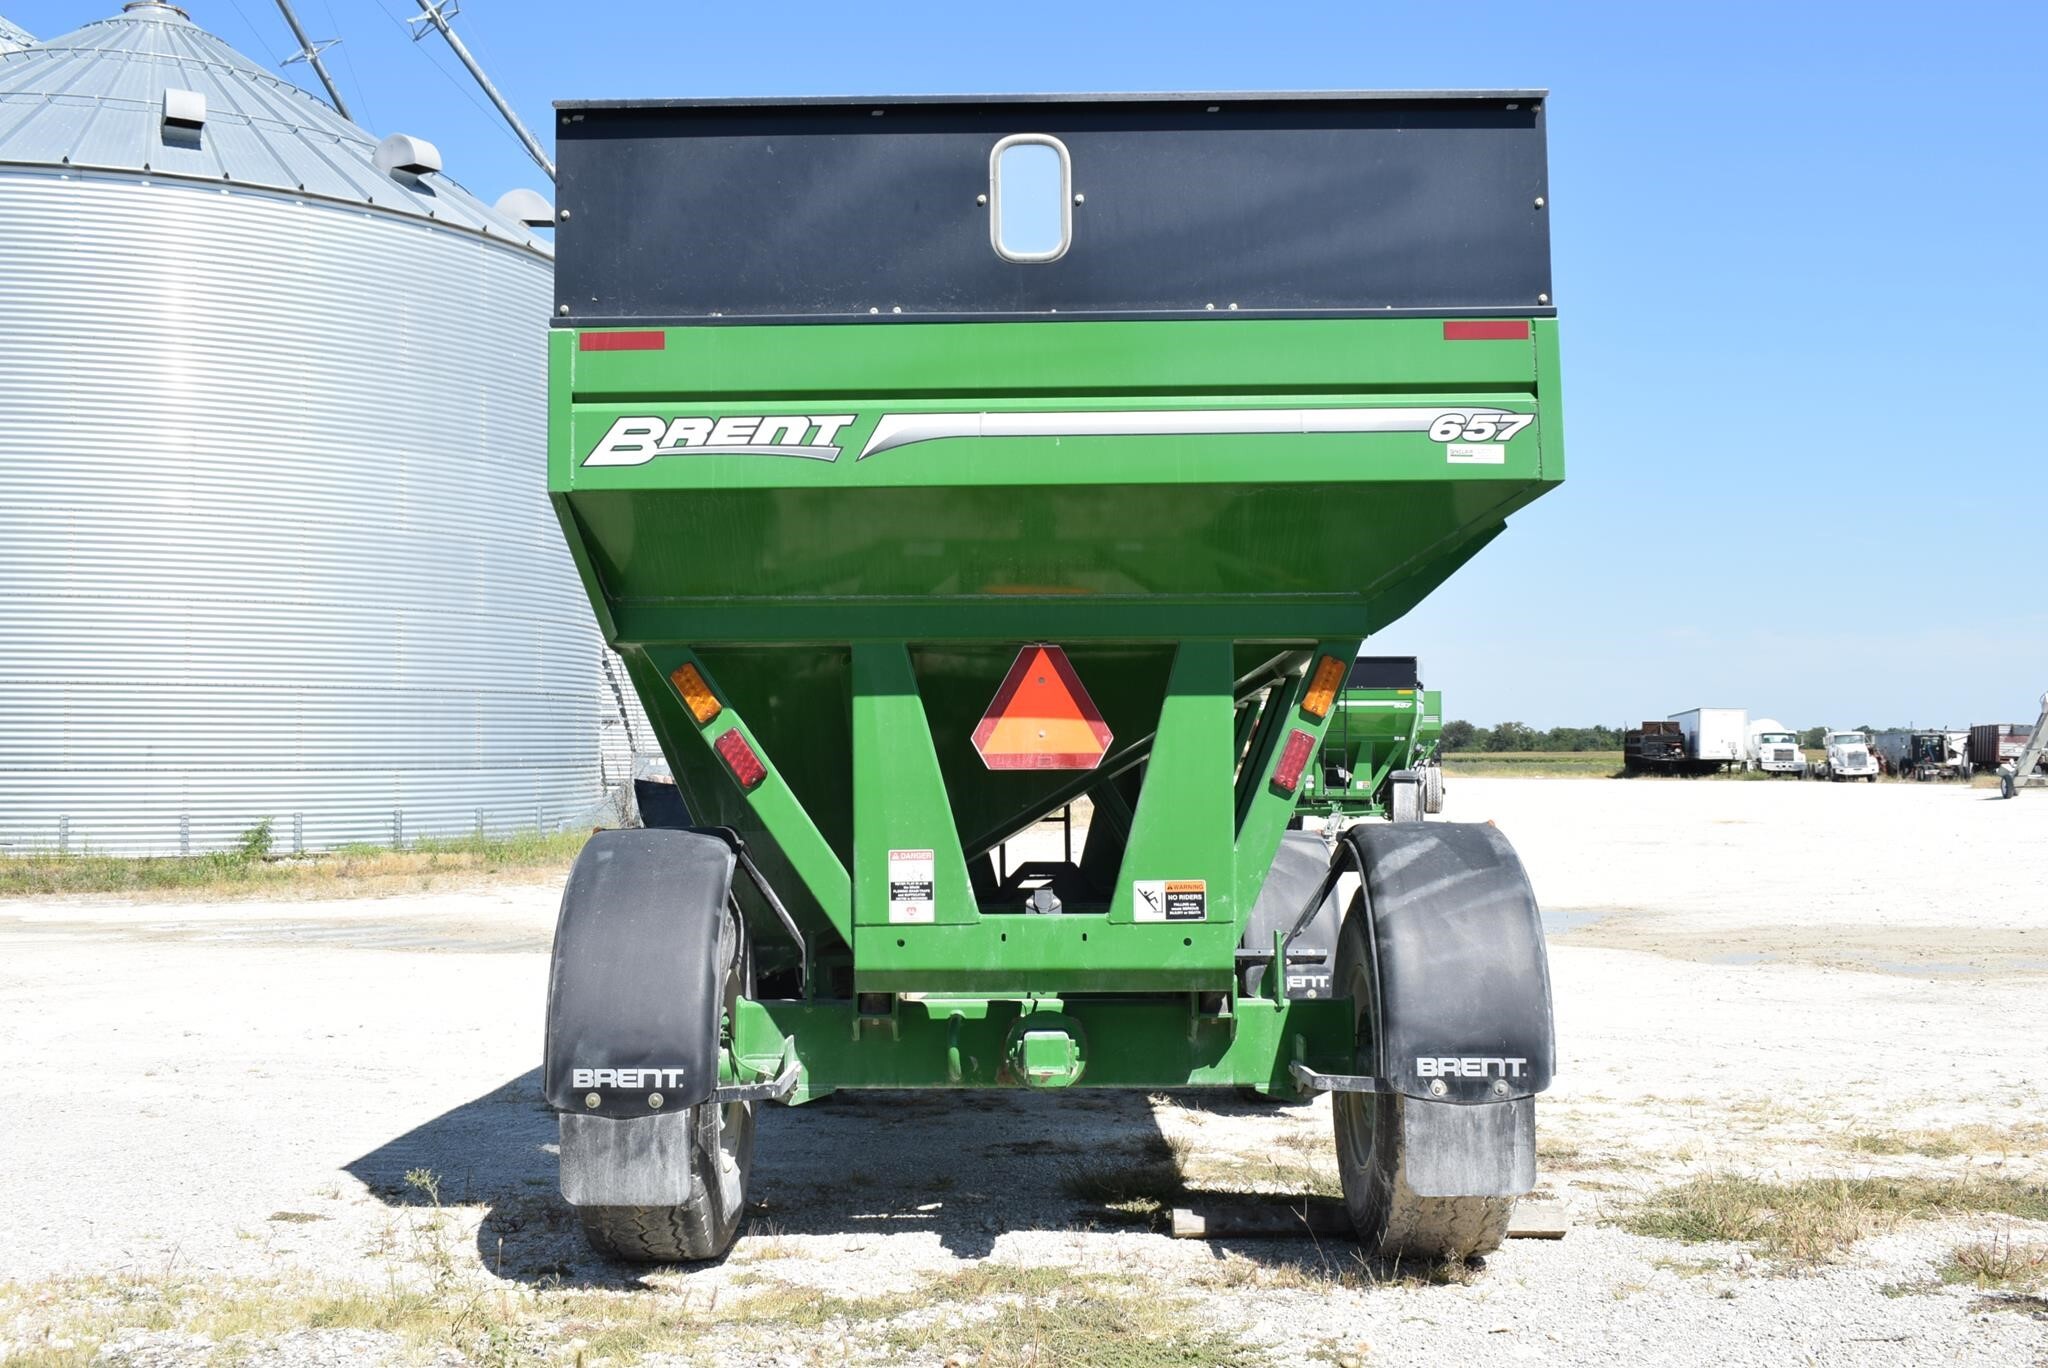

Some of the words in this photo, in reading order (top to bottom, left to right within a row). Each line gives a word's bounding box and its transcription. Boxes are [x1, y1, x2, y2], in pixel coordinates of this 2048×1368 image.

[581, 414, 858, 467] BRENT
[1428, 413, 1536, 442] 657
[901, 852, 931, 860] DANGER
